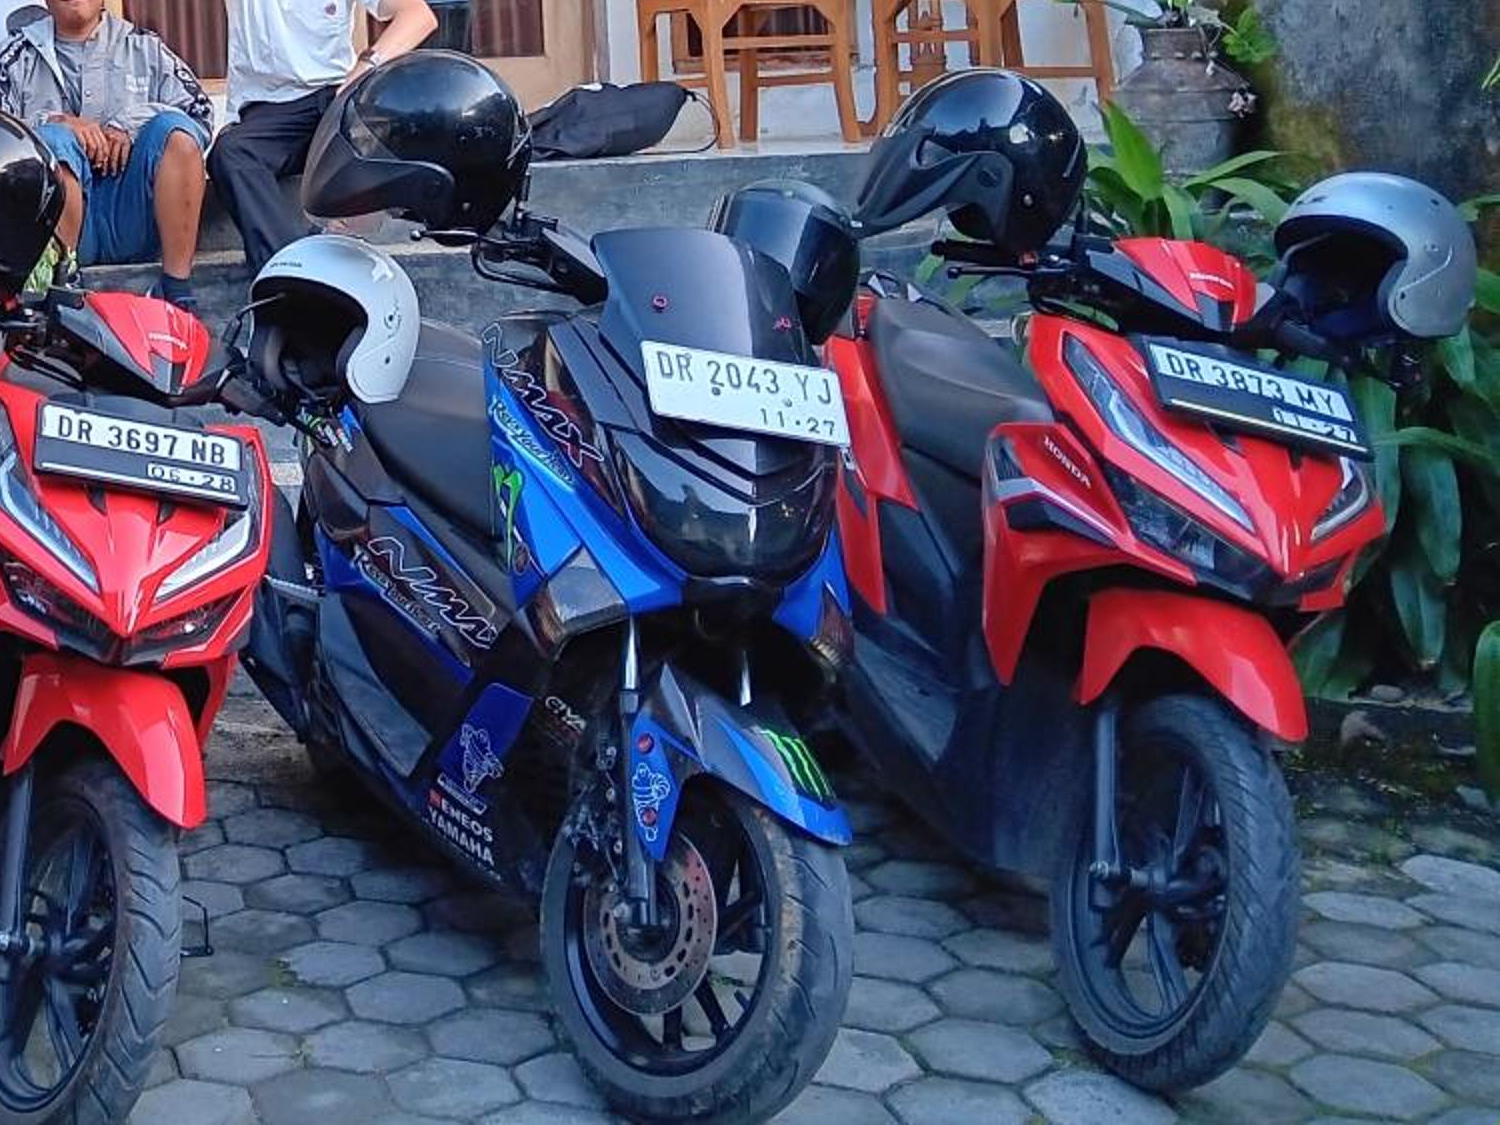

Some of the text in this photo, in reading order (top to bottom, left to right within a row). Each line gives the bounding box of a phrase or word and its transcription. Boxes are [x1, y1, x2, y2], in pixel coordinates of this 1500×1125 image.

[657, 350, 832, 405] DR 2043 YJ
[1165, 352, 1336, 417] DR 3873 MY
[57, 414, 227, 466] DR 3697 NB
[1043, 435, 1092, 490] HONDA
[428, 805, 495, 867] YAMAHA
[440, 797, 494, 843] ENEOS
